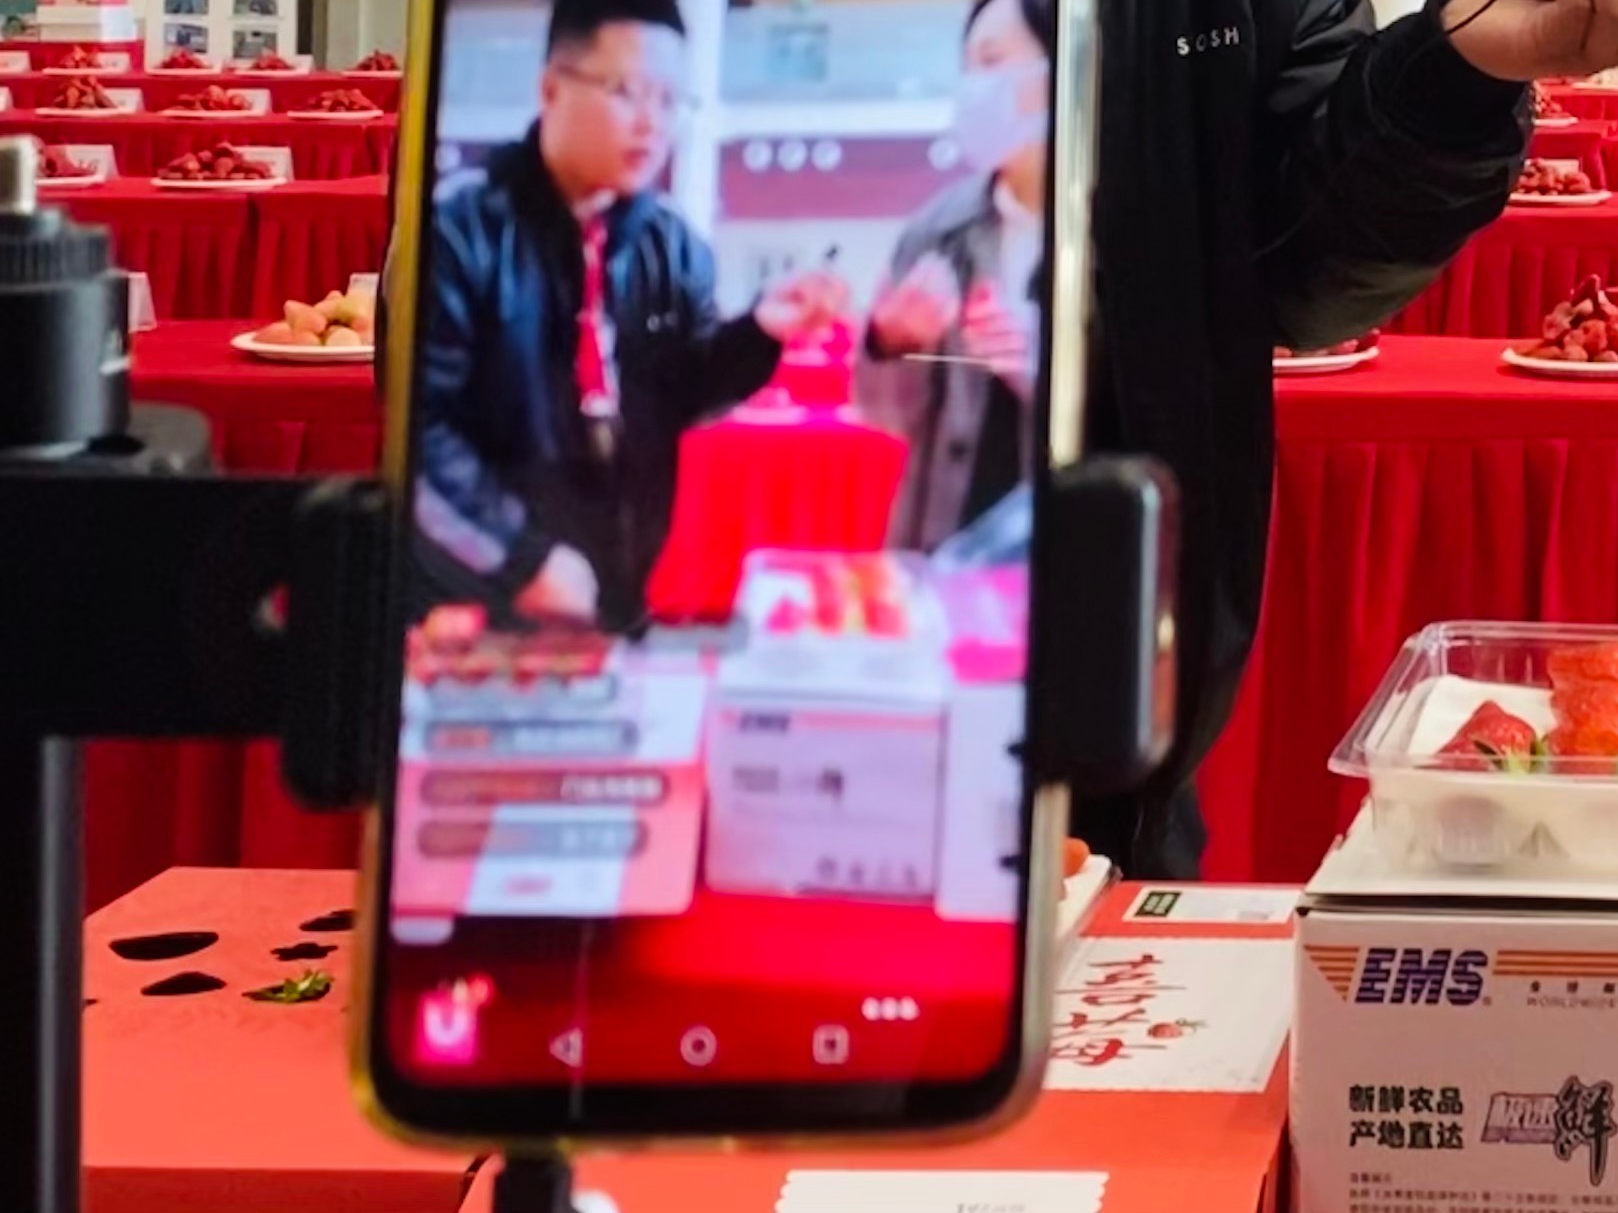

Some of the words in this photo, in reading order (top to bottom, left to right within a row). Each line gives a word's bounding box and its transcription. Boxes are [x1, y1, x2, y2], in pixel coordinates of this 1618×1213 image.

[1355, 947, 1488, 1006] EMS
[1349, 1084, 1464, 1115] 新鲜农品
[1349, 1120, 1464, 1150] 产地直达
